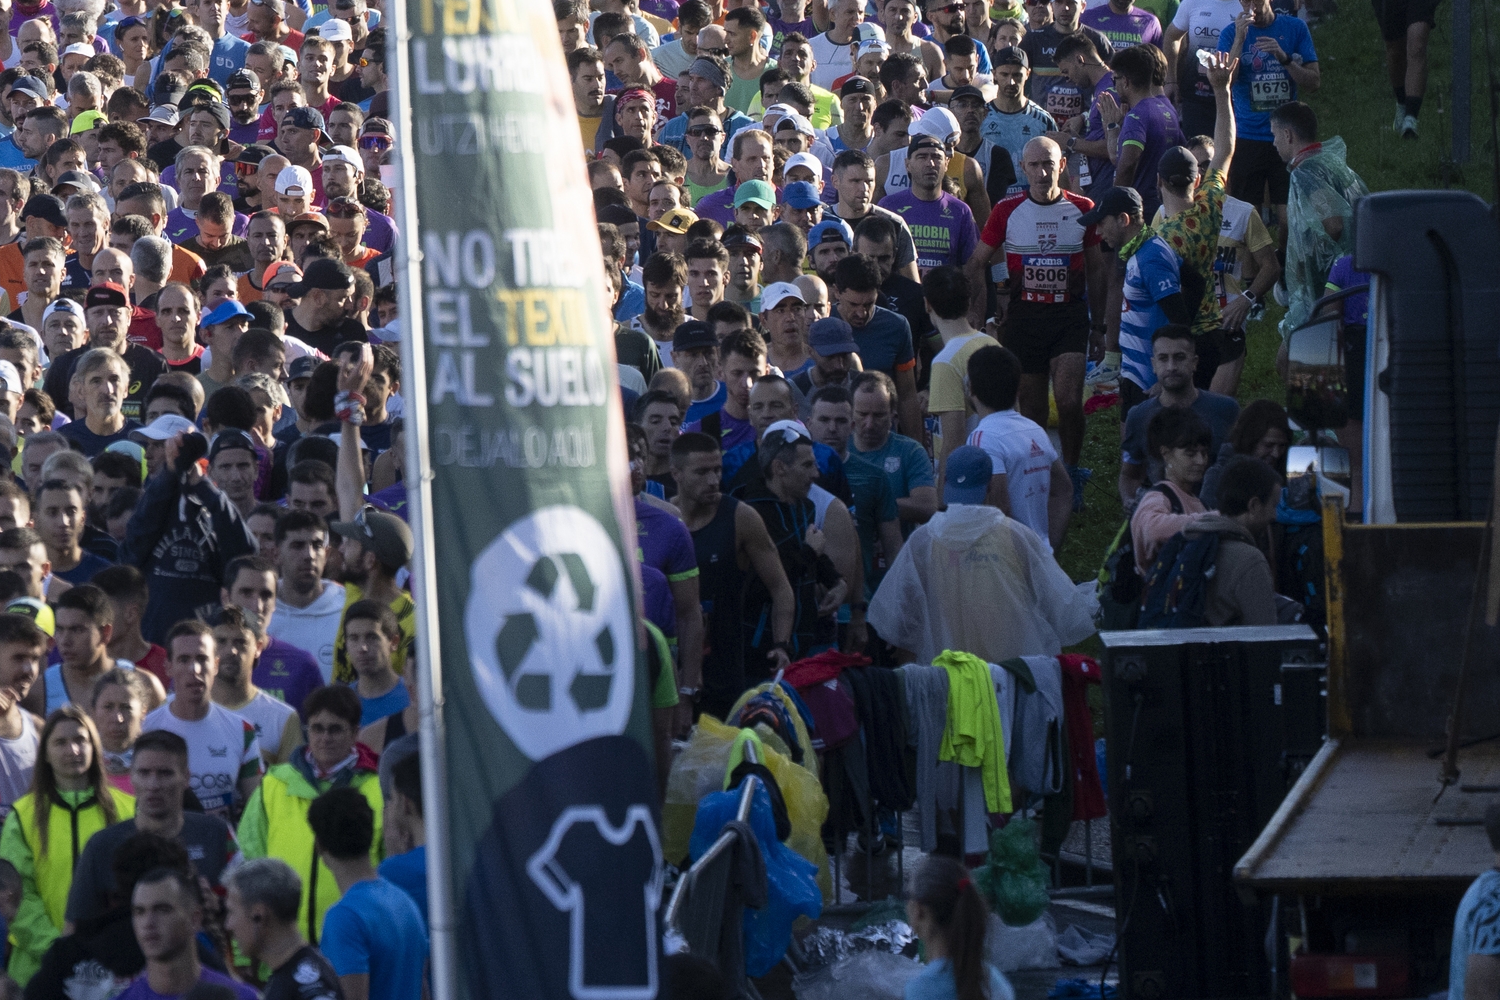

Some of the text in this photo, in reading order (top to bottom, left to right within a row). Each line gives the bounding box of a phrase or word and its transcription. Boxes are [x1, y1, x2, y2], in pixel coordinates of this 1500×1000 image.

[1108, 32, 1142, 42] EHOBIA
[1253, 82, 1290, 95] 1679
[1048, 95, 1081, 109] 3428
[905, 224, 951, 240] EHOBIA
[424, 231, 496, 289] NO
[1026, 267, 1066, 282] 3606
[1158, 279, 1173, 292] 21
[429, 290, 490, 347] EL
[431, 347, 607, 407] AL SUELO
